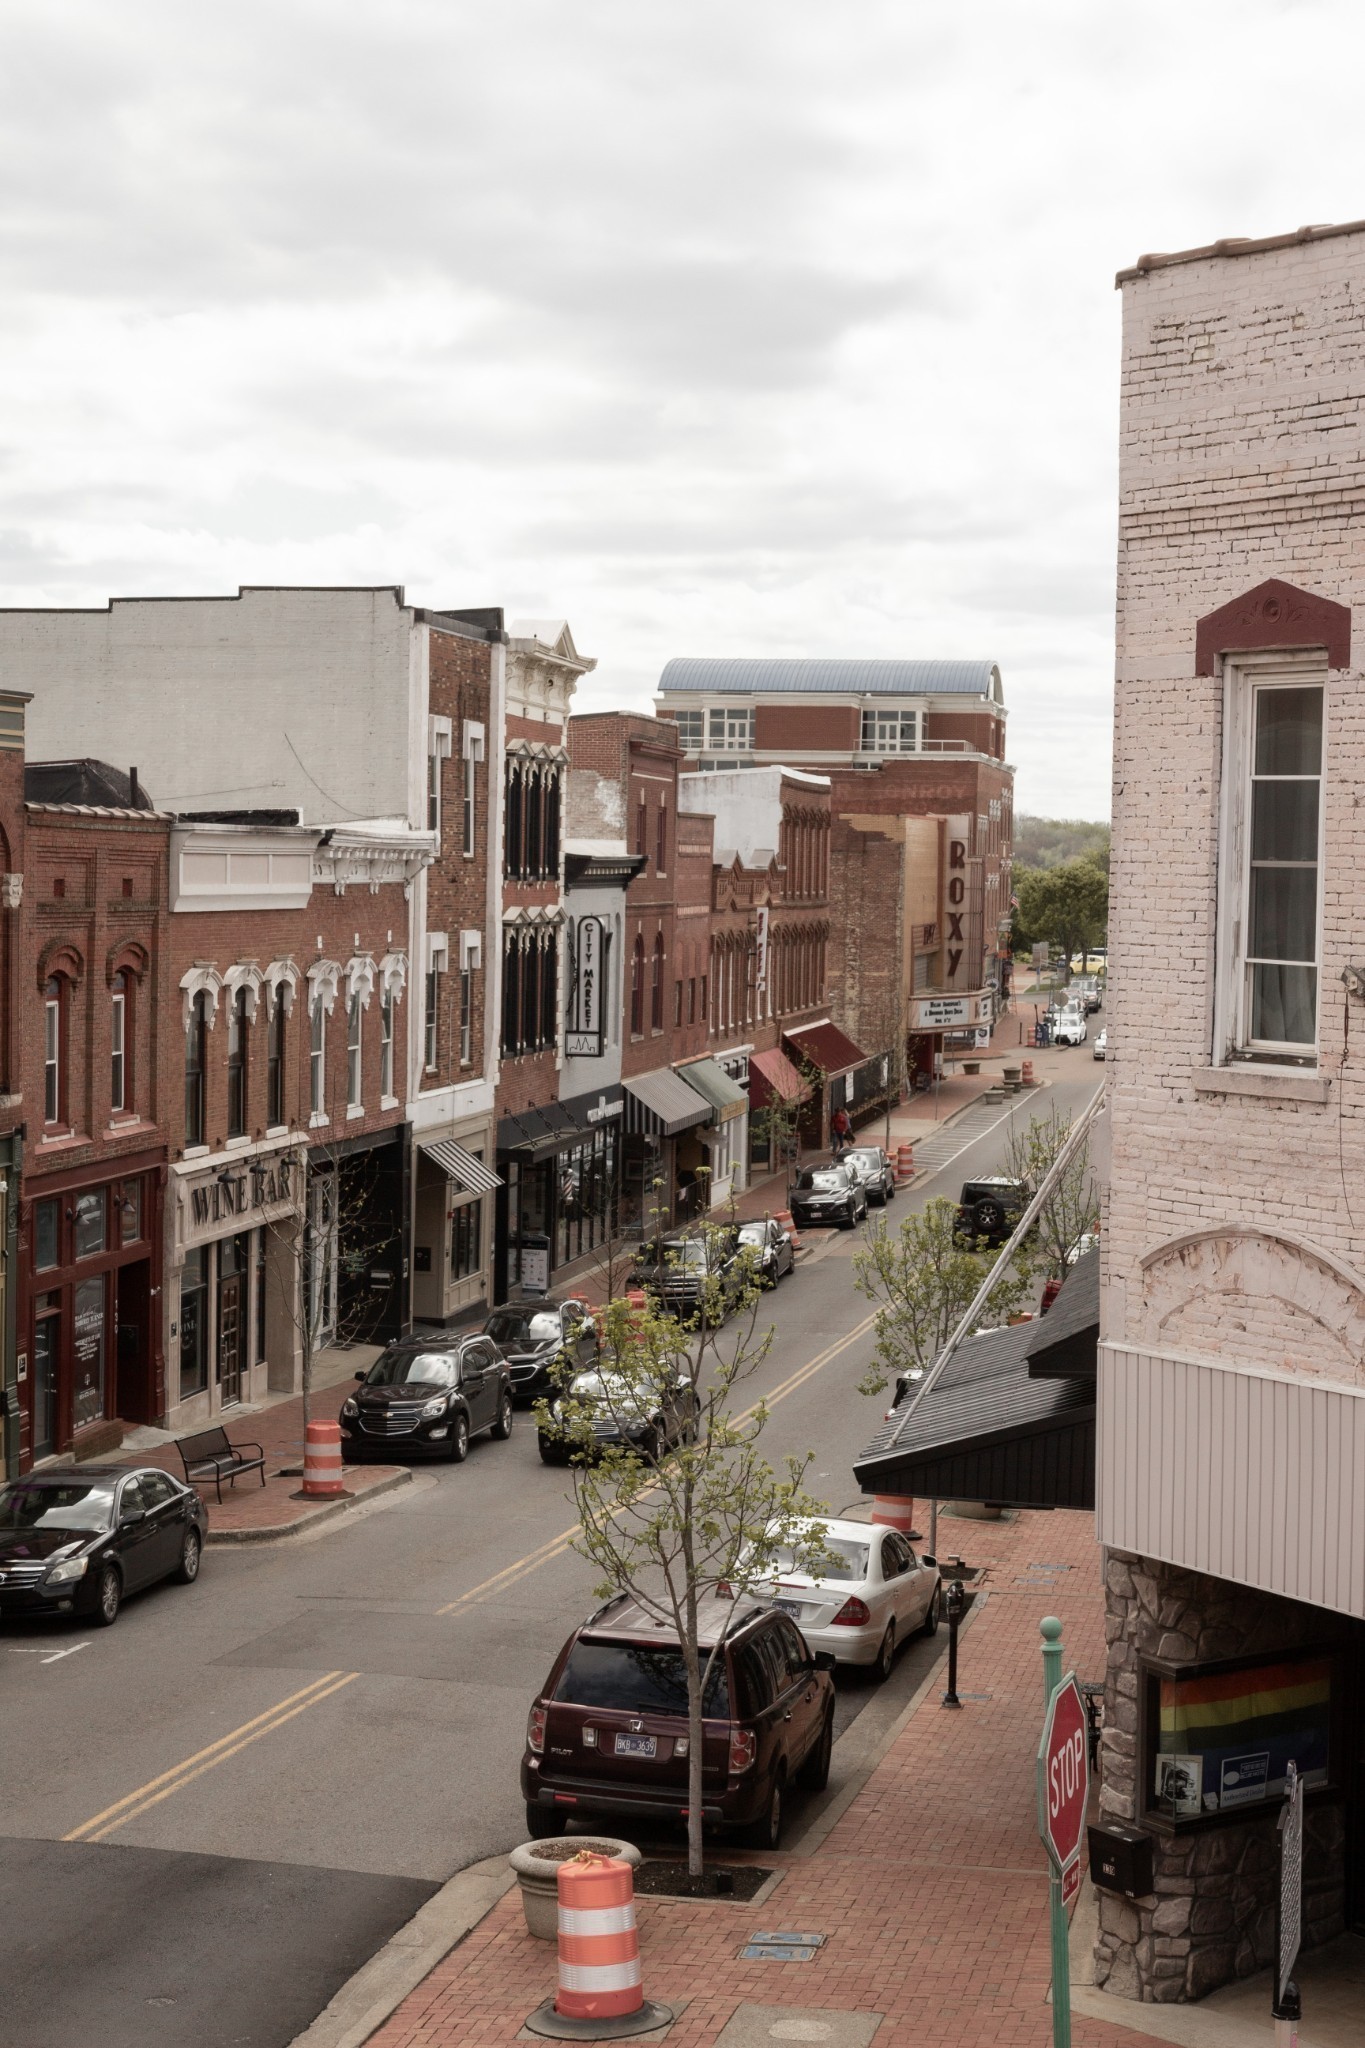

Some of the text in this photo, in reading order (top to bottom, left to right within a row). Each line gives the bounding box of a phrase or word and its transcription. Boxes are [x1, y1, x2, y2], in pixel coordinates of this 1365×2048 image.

[947, 840, 966, 977] ROXY
[583, 922, 594, 1029] CITY MARKET
[191, 1162, 291, 1227] WINE BAR
[550, 1746, 573, 1756] PILOT
[617, 1738, 655, 1752] BKB 3639
[1051, 1727, 1083, 1819] STOP
